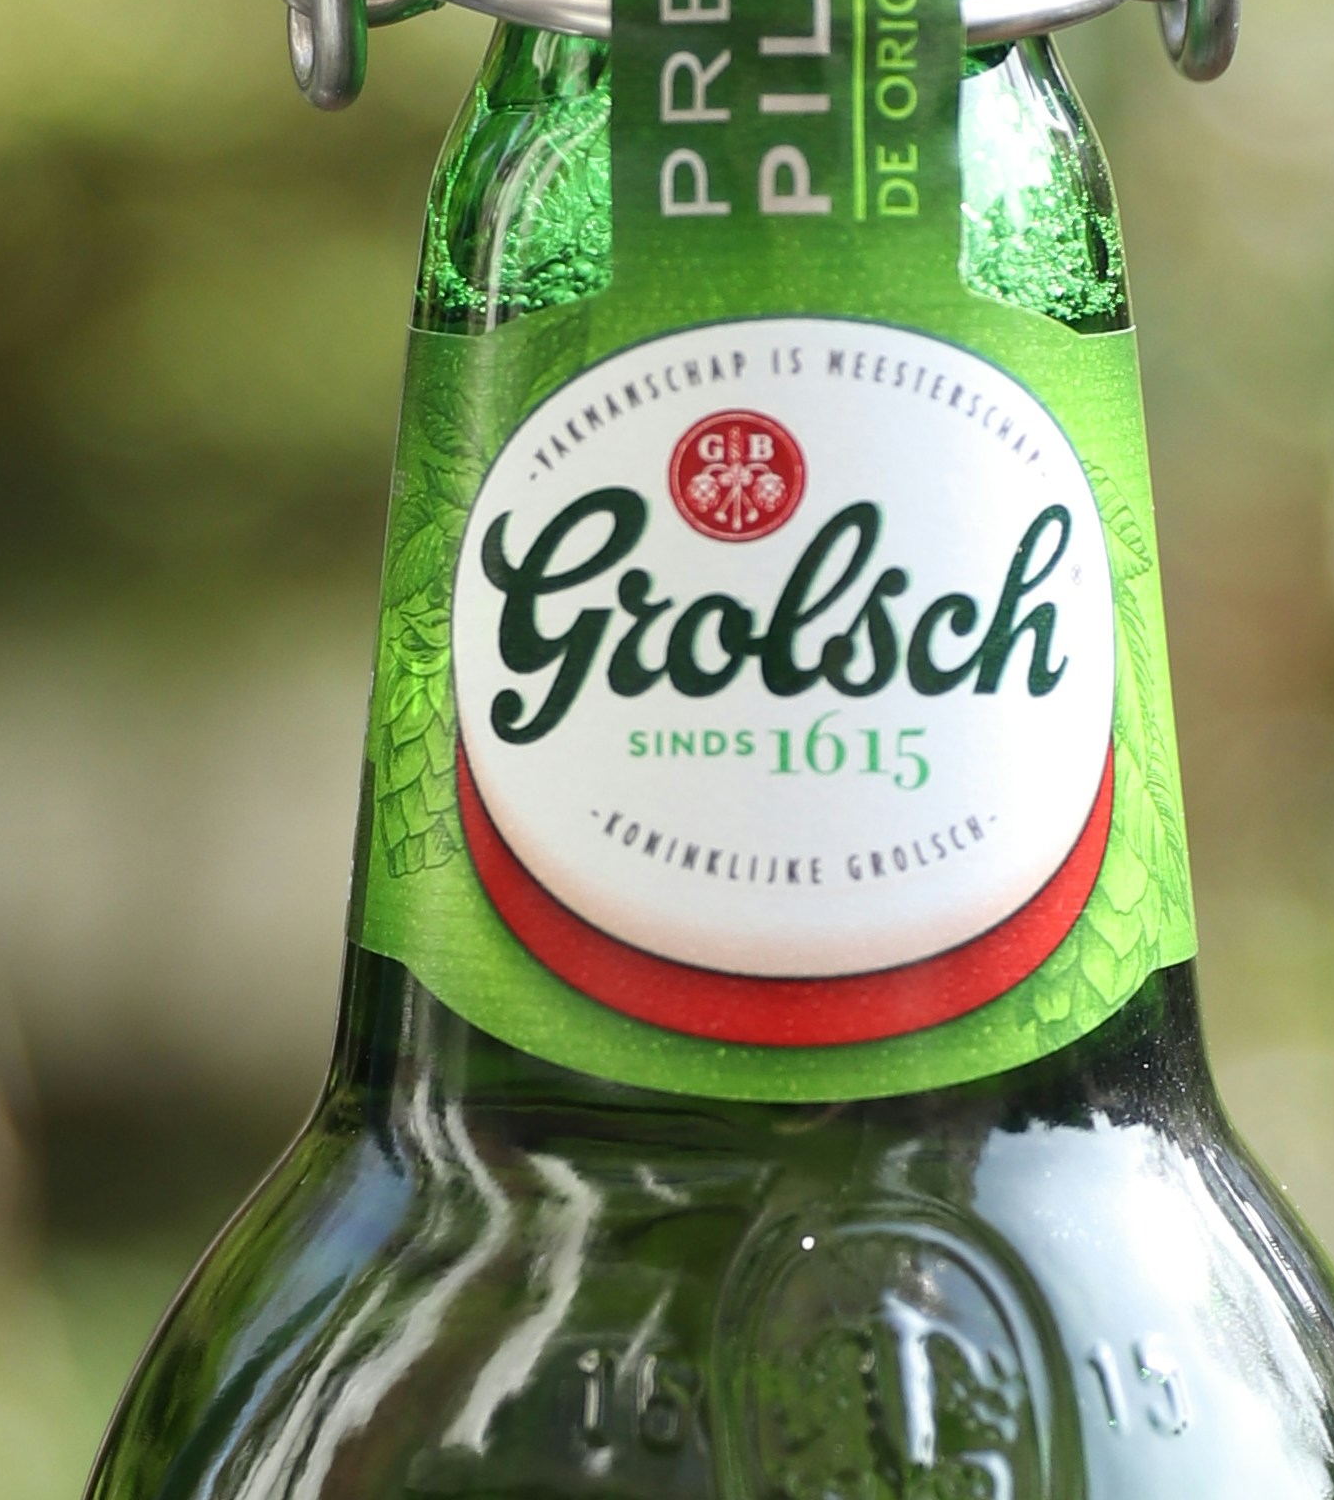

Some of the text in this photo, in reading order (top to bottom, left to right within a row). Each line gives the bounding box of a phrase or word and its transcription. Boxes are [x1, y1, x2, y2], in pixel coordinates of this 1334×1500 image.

[876, 143, 920, 219] DE
[772, 346, 804, 375] IS
[697, 433, 775, 464] G B
[480, 485, 1072, 745] Grolsch
[628, 709, 931, 791] SINDS 1615
